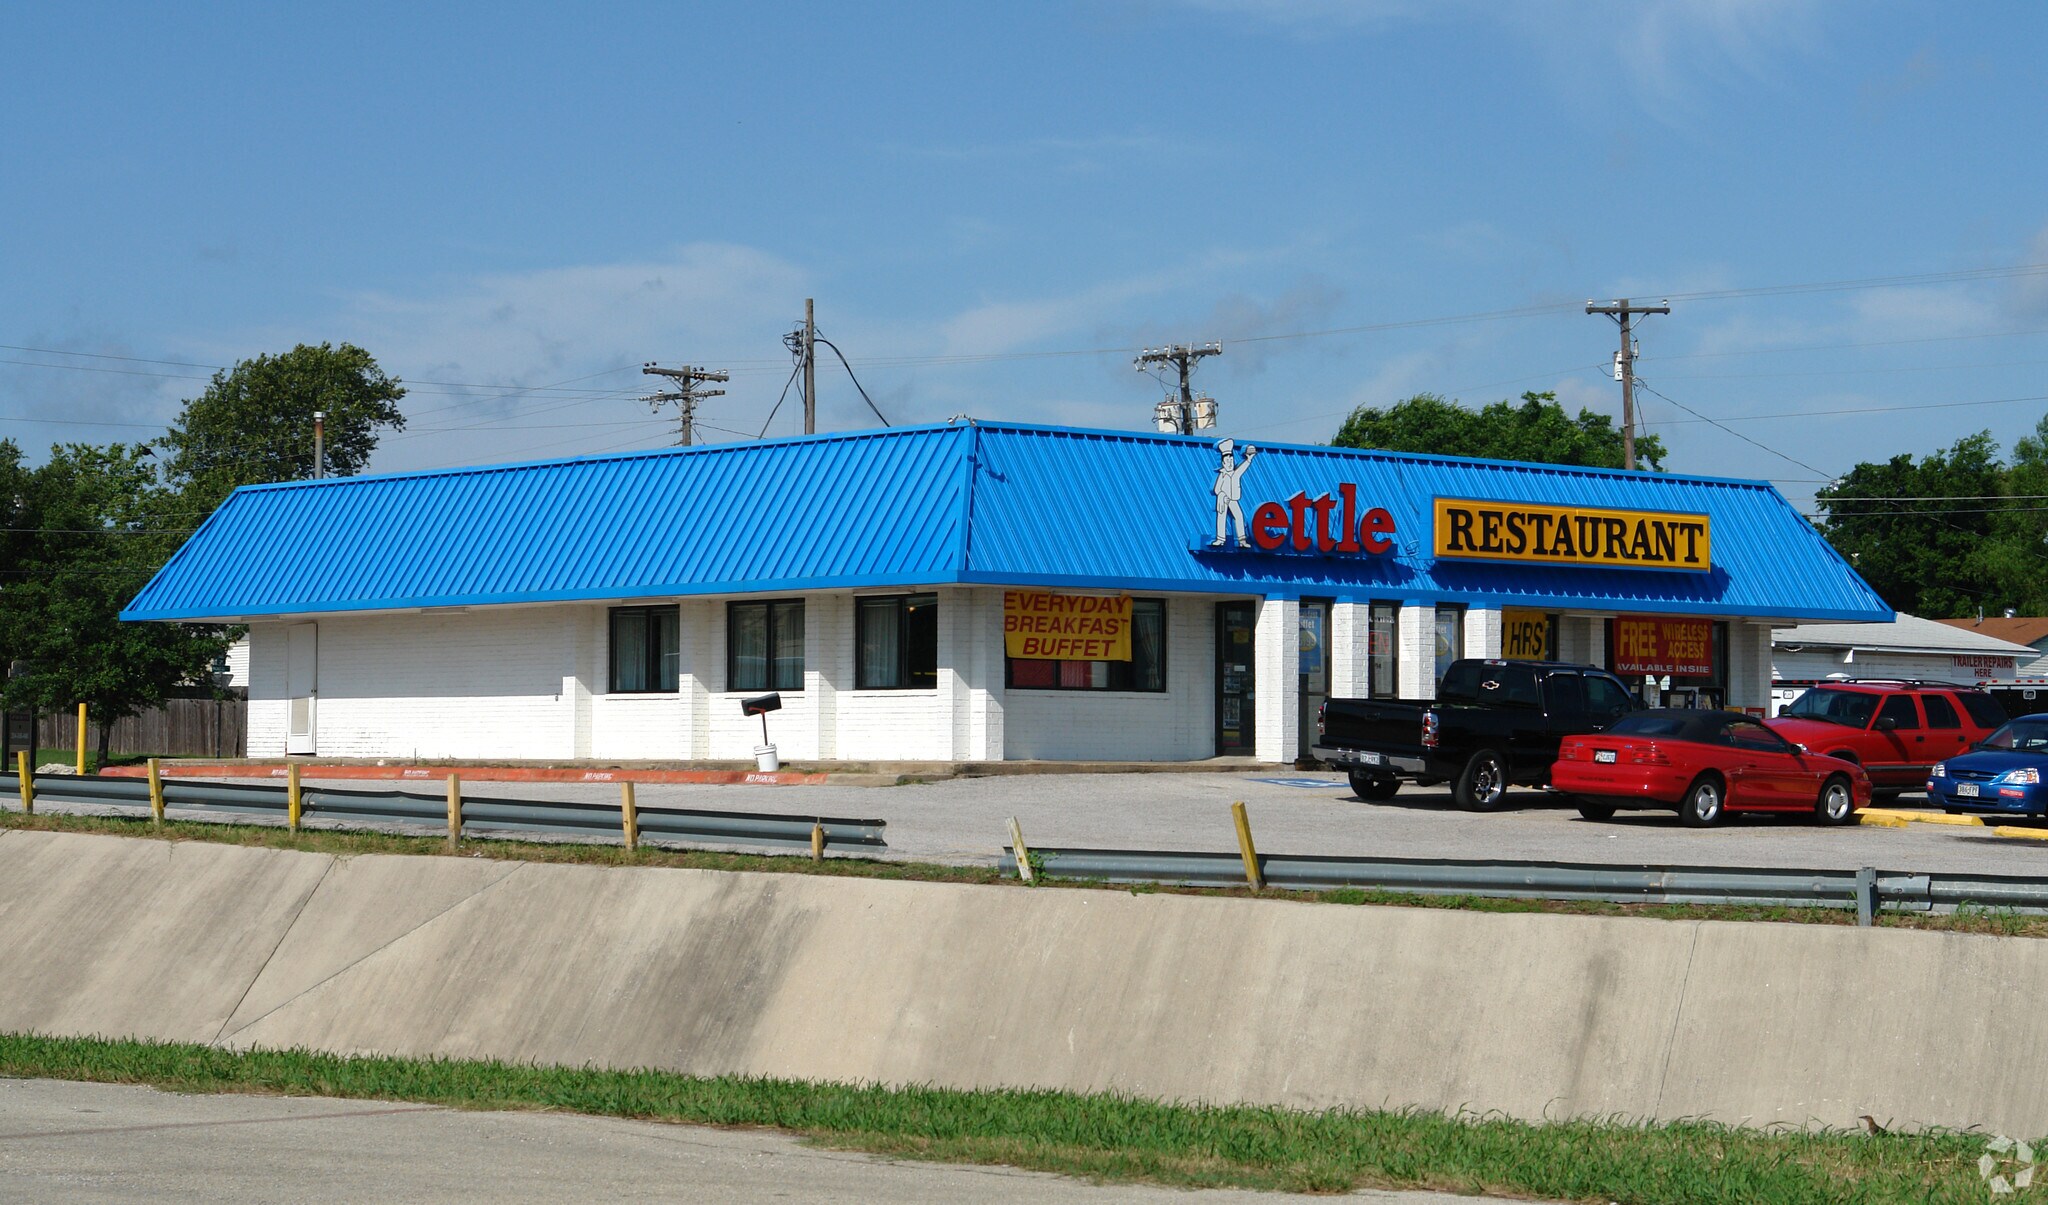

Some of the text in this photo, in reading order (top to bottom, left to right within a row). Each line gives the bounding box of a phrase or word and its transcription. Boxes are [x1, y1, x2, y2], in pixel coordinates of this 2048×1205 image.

[1446, 508, 1704, 563] RESTAURANT
[1004, 591, 1129, 614] EVERYDAY
[1509, 621, 1544, 656] HRS
[1619, 621, 1657, 657] FREE
[1662, 623, 1709, 641] WIRELESS
[1022, 637, 1117, 657] BUFFET
[1666, 641, 1705, 659] ACCESS
[1953, 655, 2013, 669] TRAILER REPAIRS
[1974, 668, 1992, 678] HERE
